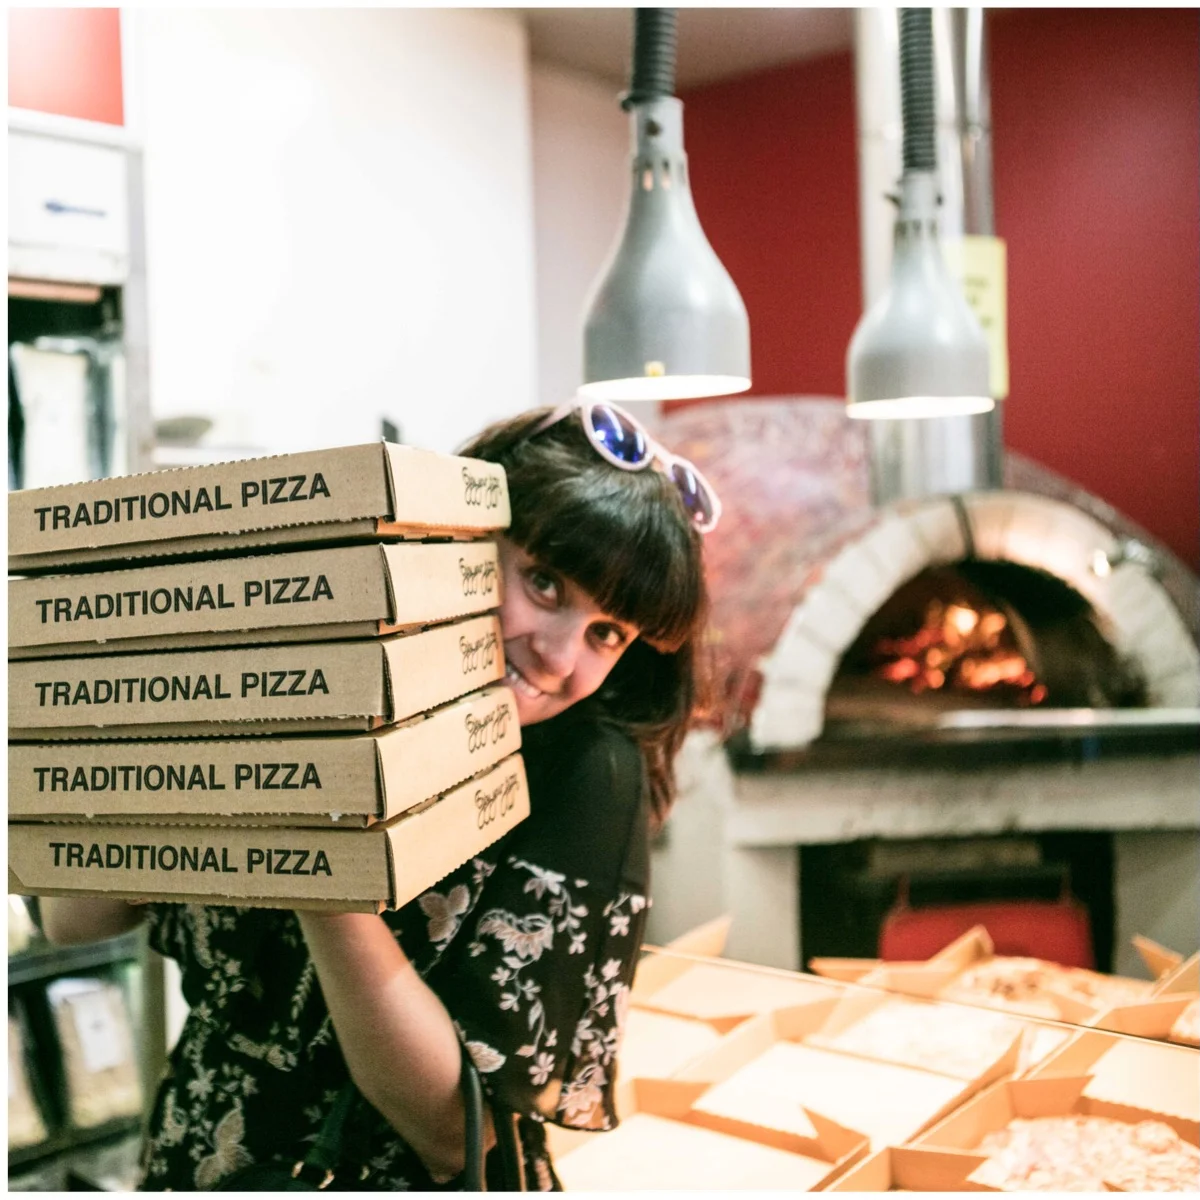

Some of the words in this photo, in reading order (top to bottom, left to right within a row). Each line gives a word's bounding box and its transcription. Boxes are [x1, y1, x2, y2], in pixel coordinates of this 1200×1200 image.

[35, 485, 232, 531] TRADITIONAL
[241, 472, 331, 507] PIZZA
[36, 582, 235, 624] TRADITIONAL
[243, 574, 334, 607] PIZZA
[35, 674, 231, 707] TRADITIONAL
[241, 669, 330, 700] PIZZA
[34, 763, 225, 792] TRADITIONAL
[234, 763, 322, 790] PIZZA
[49, 842, 238, 873] TRADITIONAL
[246, 849, 332, 877] PIZZA
